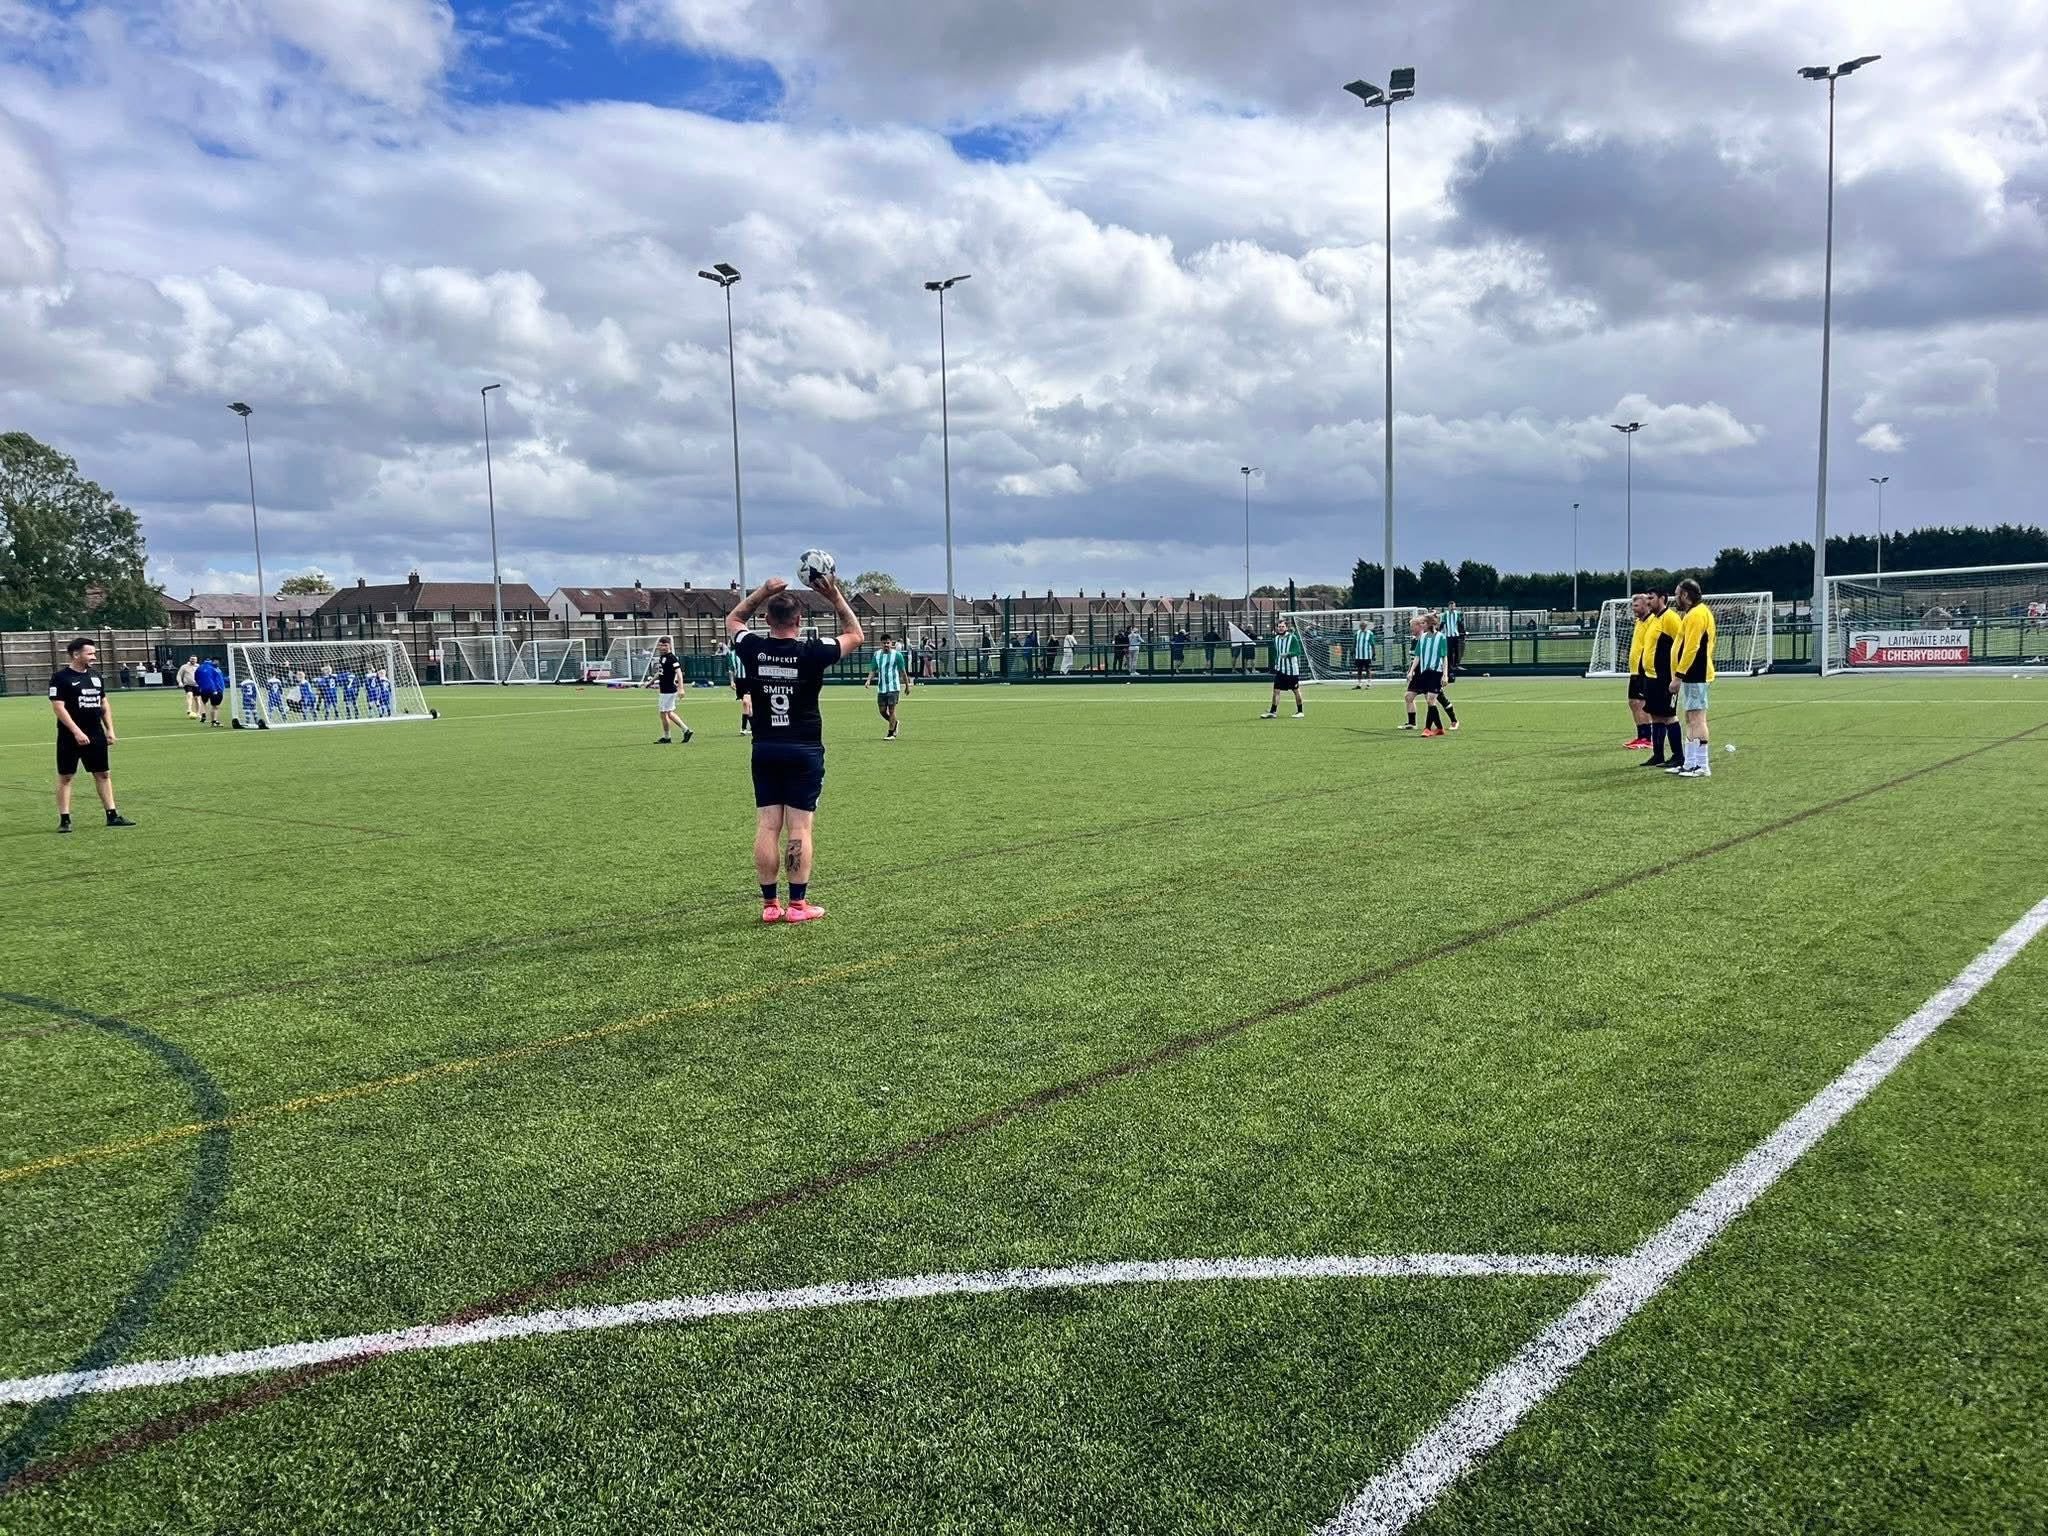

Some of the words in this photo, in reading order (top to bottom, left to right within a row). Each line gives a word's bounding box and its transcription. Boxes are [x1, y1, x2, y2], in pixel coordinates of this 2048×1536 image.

[1888, 635, 1937, 646] LAITHWAITE
[1940, 635, 1962, 645] PARK
[1887, 649, 1963, 661] CHERRYBROOK
[763, 685, 793, 694] SMITH
[771, 694, 789, 715] 9
